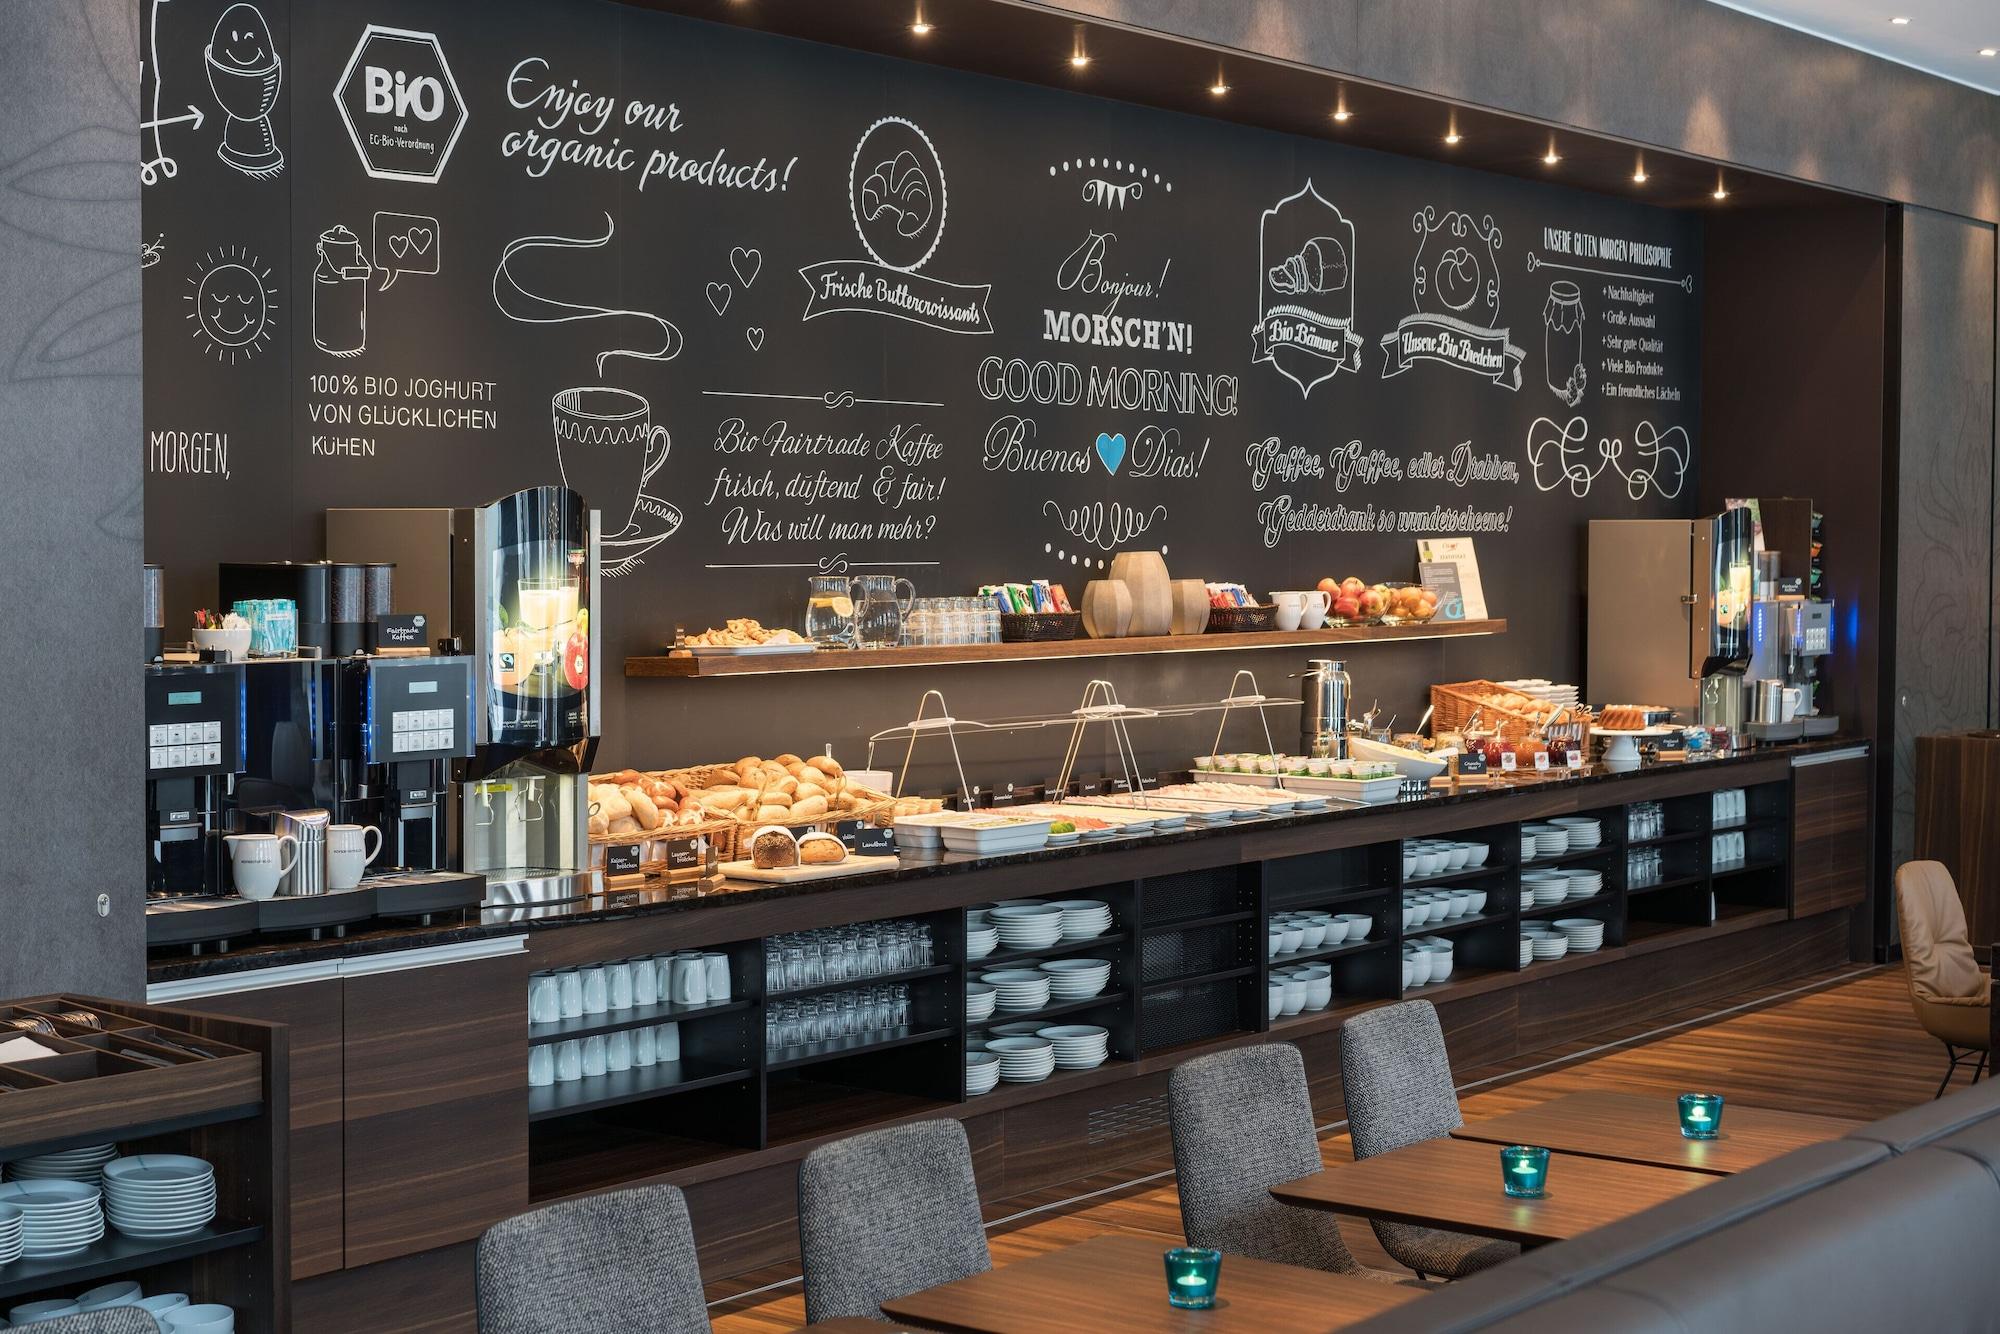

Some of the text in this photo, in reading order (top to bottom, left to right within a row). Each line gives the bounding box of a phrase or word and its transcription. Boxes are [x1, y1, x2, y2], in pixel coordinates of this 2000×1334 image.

[506, 57, 683, 135] Enjoy our
[393, 124, 408, 133] nach
[501, 127, 799, 192] organic products!
[1544, 227, 1673, 269] UNSERE GUTEN MORGEN PHILOSOPHIE
[1057, 229, 1171, 318] Bonjour!
[820, 271, 981, 325] Frische Buttercroissants
[1608, 285, 1655, 307] Nachhaltigkeit
[1043, 309, 1193, 354] MORSCH'N!
[1268, 319, 1293, 343] Bio
[1607, 310, 1628, 325] Große
[1628, 313, 1656, 328] Auswahl
[1401, 332, 1503, 368] Unsere Bio Bredchen
[1607, 335, 1622, 349] Sehr
[1623, 338, 1638, 353] gute
[1638, 338, 1664, 353] Qualität
[1607, 358, 1623, 373] Viele
[1625, 360, 1636, 374] Bio
[1635, 361, 1664, 376] Produkte
[309, 374, 497, 402] 100% BIO JOGHURT
[978, 356, 1239, 416] GOOD MORNING!
[1606, 382, 1618, 396] Ein
[1617, 383, 1656, 400] freundliches
[1655, 386, 1681, 401] Lächeln
[308, 403, 497, 429] VON GLÜCKLICHEN
[150, 430, 232, 480] MORGEN,
[312, 436, 376, 457] KÜHEN
[714, 417, 943, 466] Bio Fairtrade Kaffee
[983, 415, 1211, 479] Buenos Dias!
[1246, 436, 1520, 493] Gaffee, Gaffee, edler Drobben,
[704, 467, 780, 506] frisch,
[872, 465, 896, 505] &
[892, 473, 947, 509] fair!
[721, 506, 937, 545] Was will man mehr?
[1376, 510, 1396, 532] so
[1397, 505, 1513, 533] wunderscheene!
[386, 626, 420, 635] Fairtrade
[391, 633, 415, 642] Kaffee
